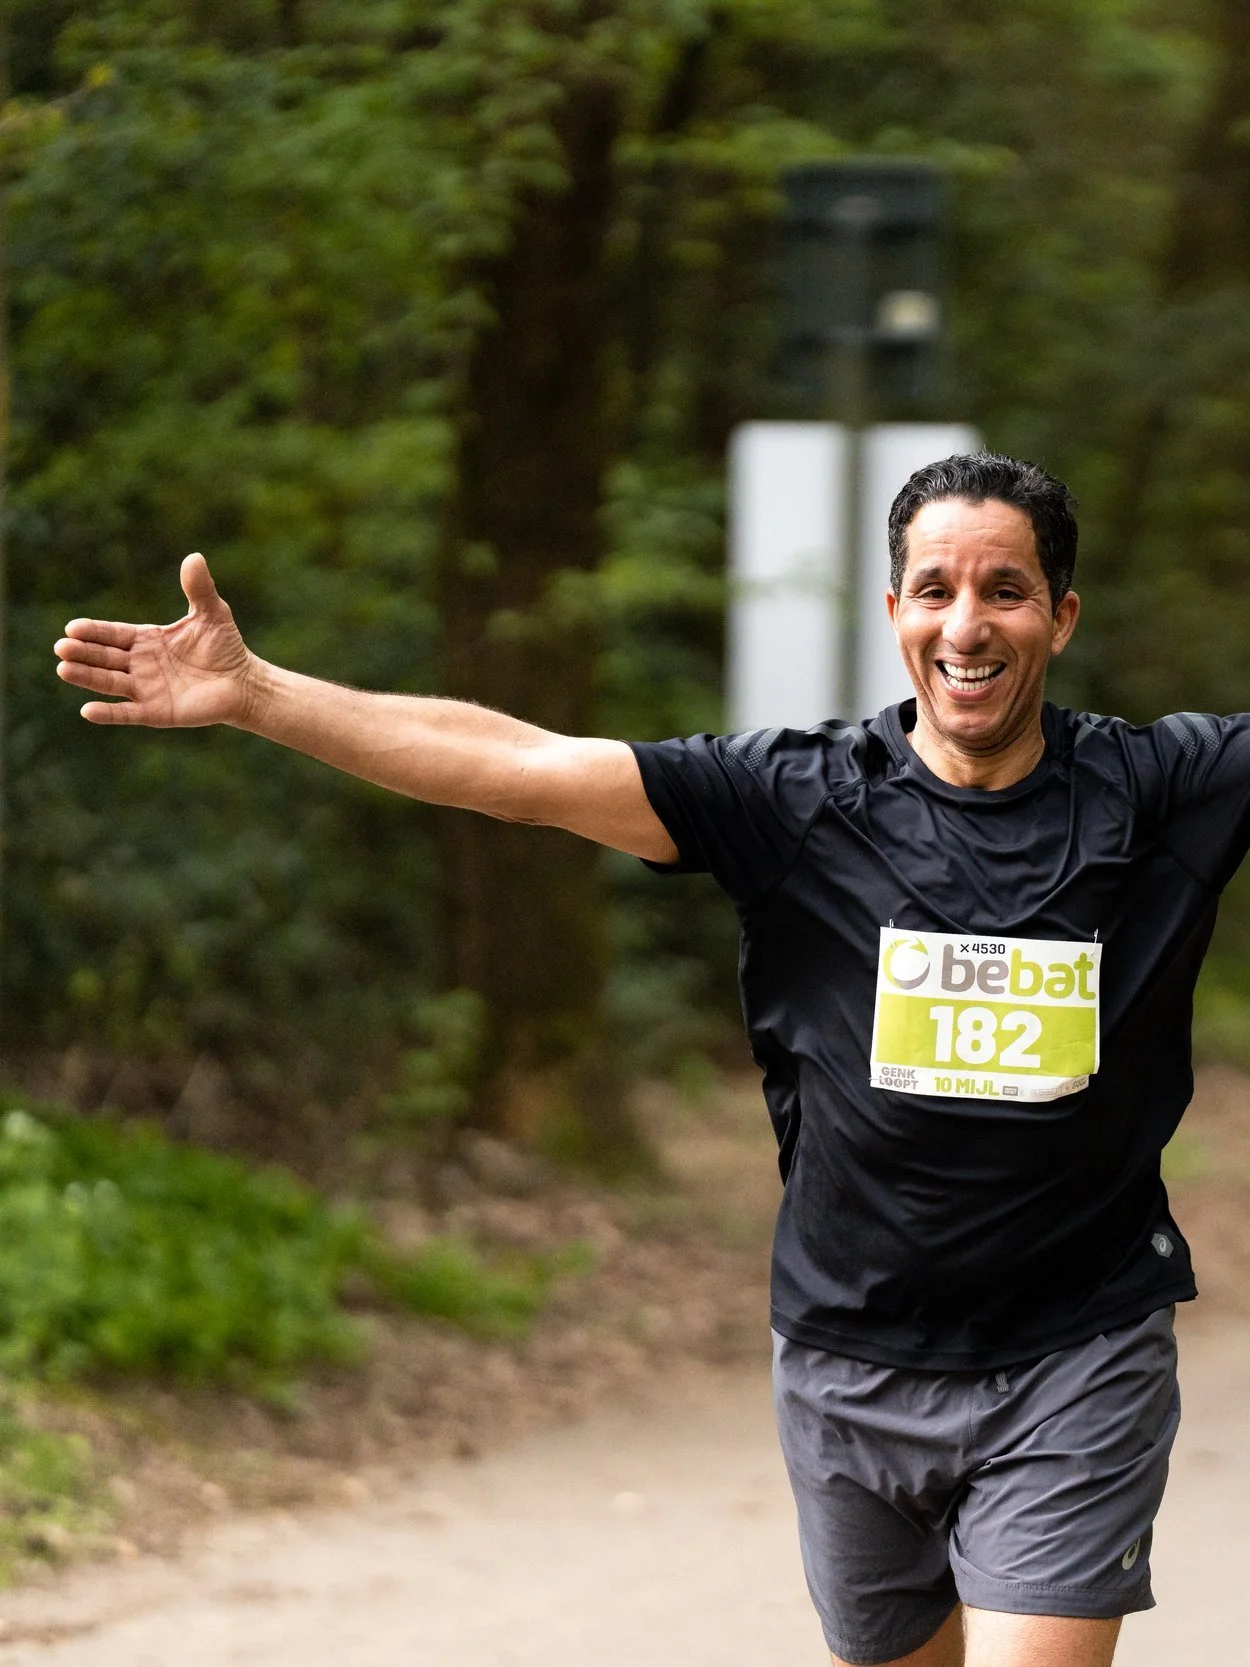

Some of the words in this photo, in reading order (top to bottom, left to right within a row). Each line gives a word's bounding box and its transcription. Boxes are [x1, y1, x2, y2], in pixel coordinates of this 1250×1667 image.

[940, 943, 1097, 1001] bebat
[929, 1005, 1042, 1068] 182
[879, 1075, 919, 1090] LOOPT
[881, 1066, 916, 1080] GENK
[934, 1076, 952, 1093] 10
[955, 1078, 1000, 1096] MIJL
